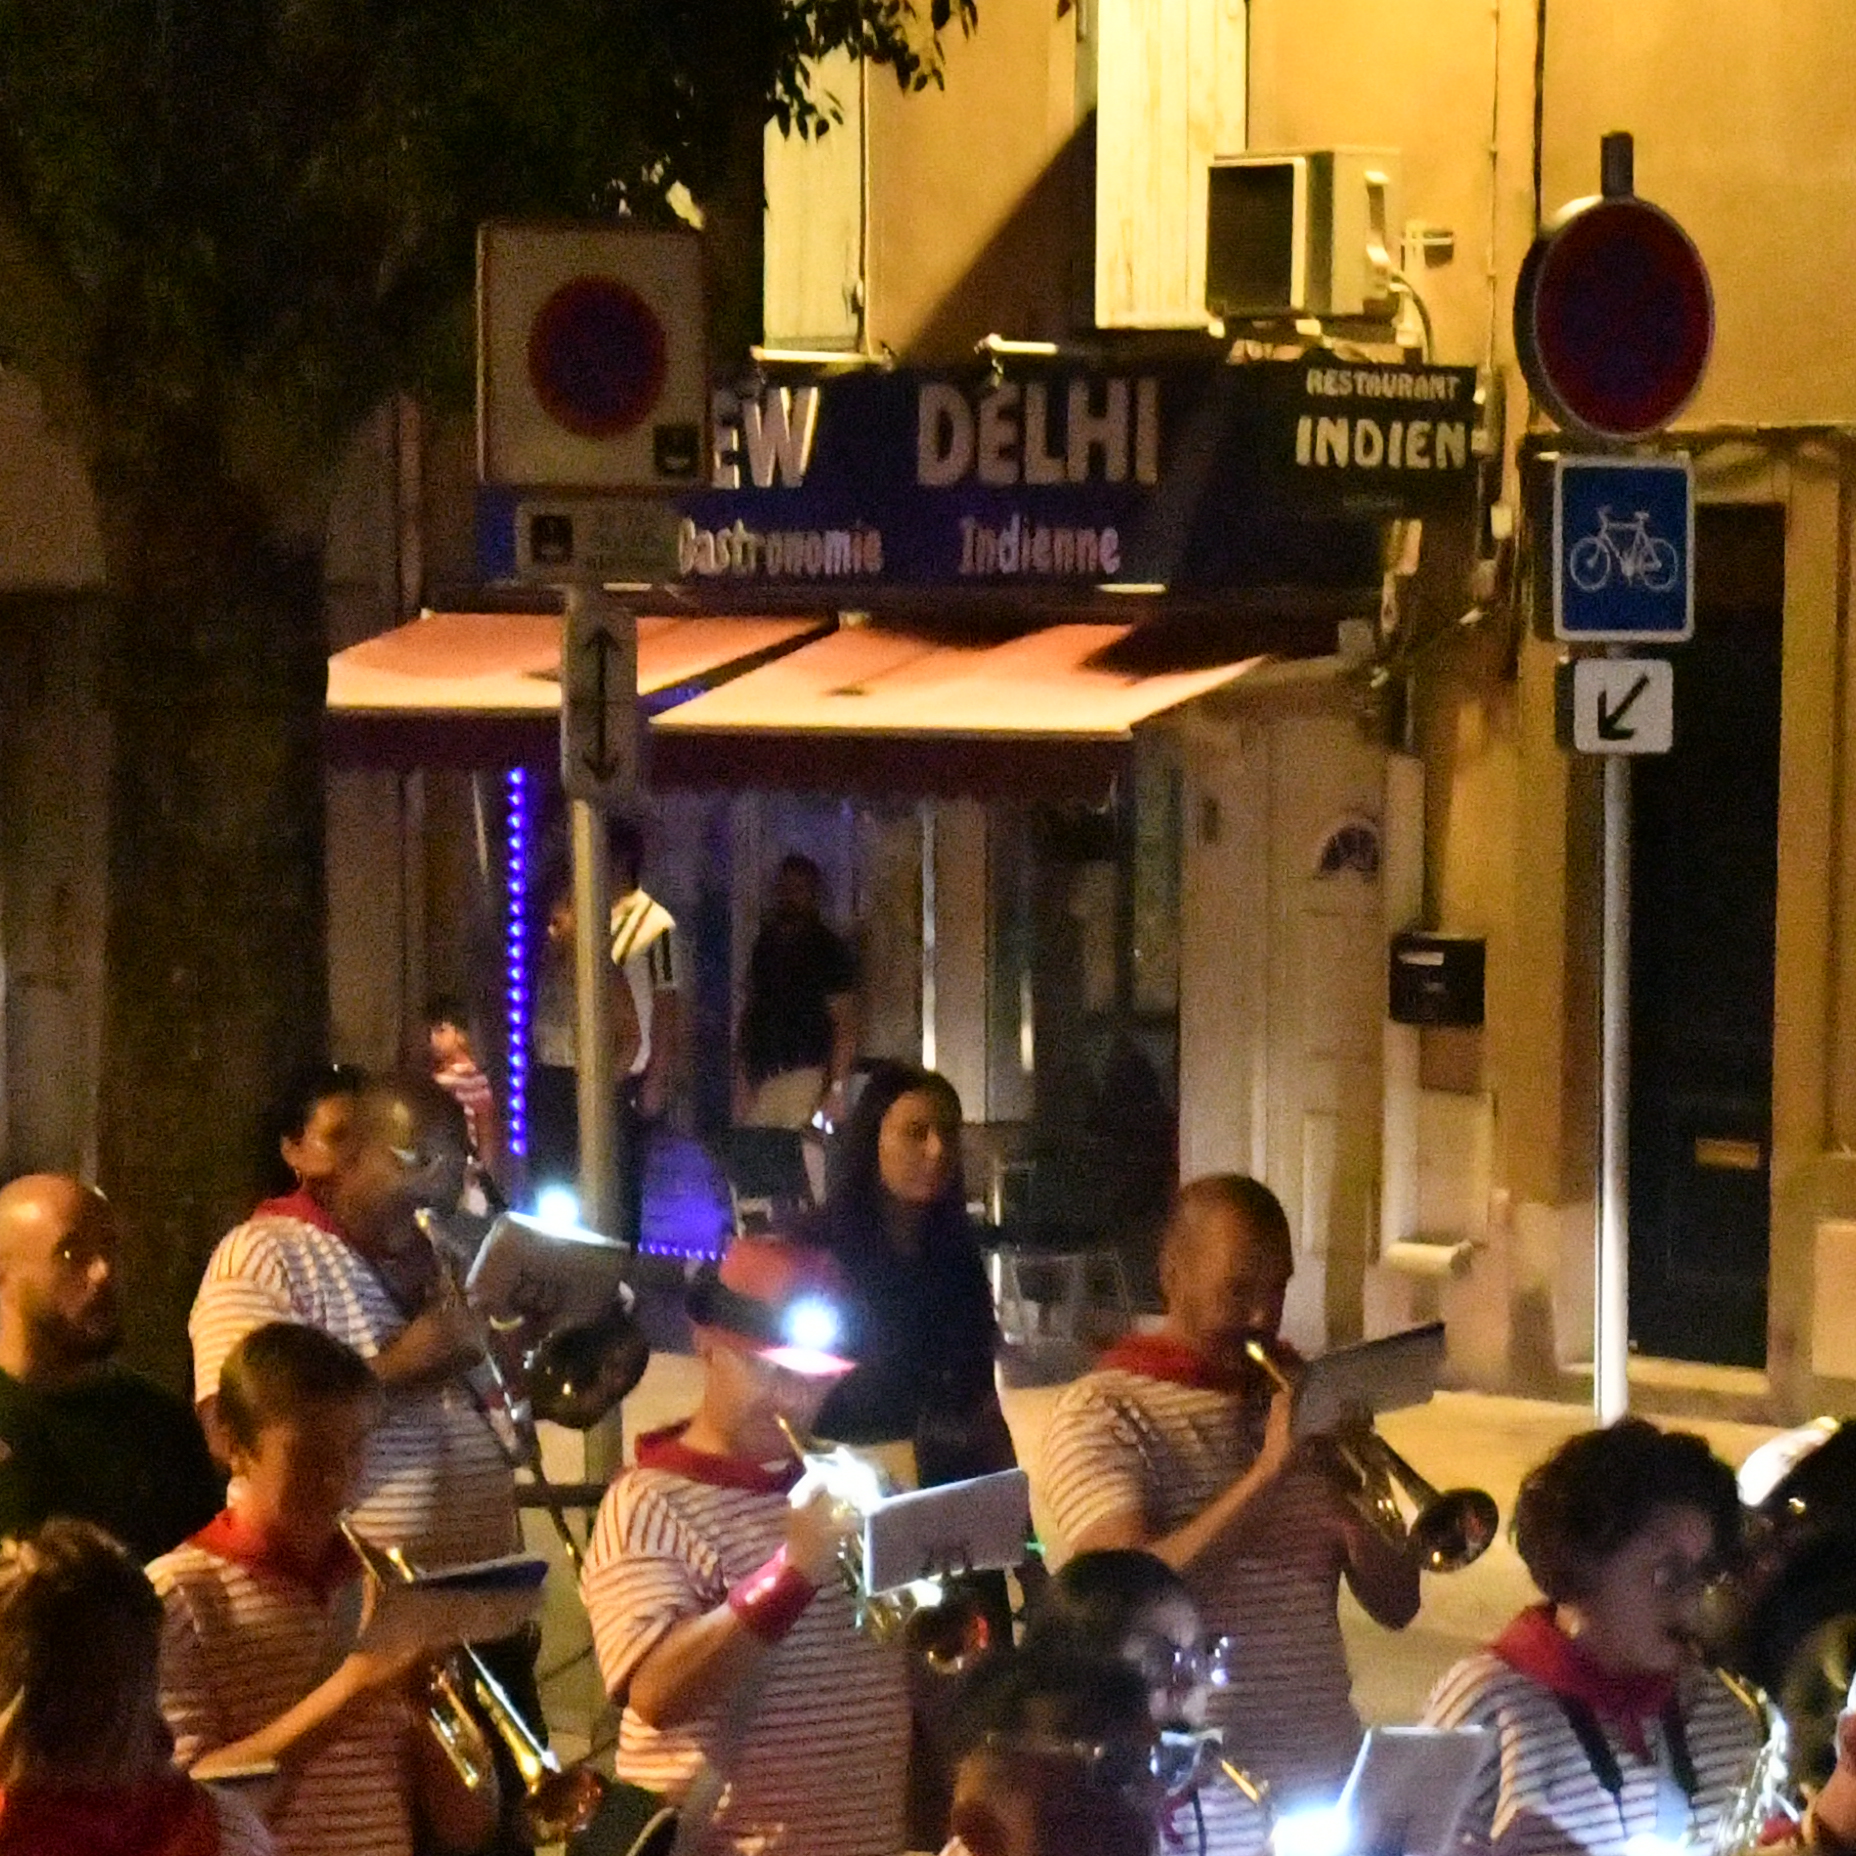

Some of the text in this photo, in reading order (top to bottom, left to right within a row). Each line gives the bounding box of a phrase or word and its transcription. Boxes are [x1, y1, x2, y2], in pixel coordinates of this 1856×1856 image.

[1307, 368, 1460, 400] RESTAURANT
[711, 378, 1160, 488] EW DELHI
[1296, 415, 1466, 470] INDIEN
[961, 513, 1121, 577] Indienne
